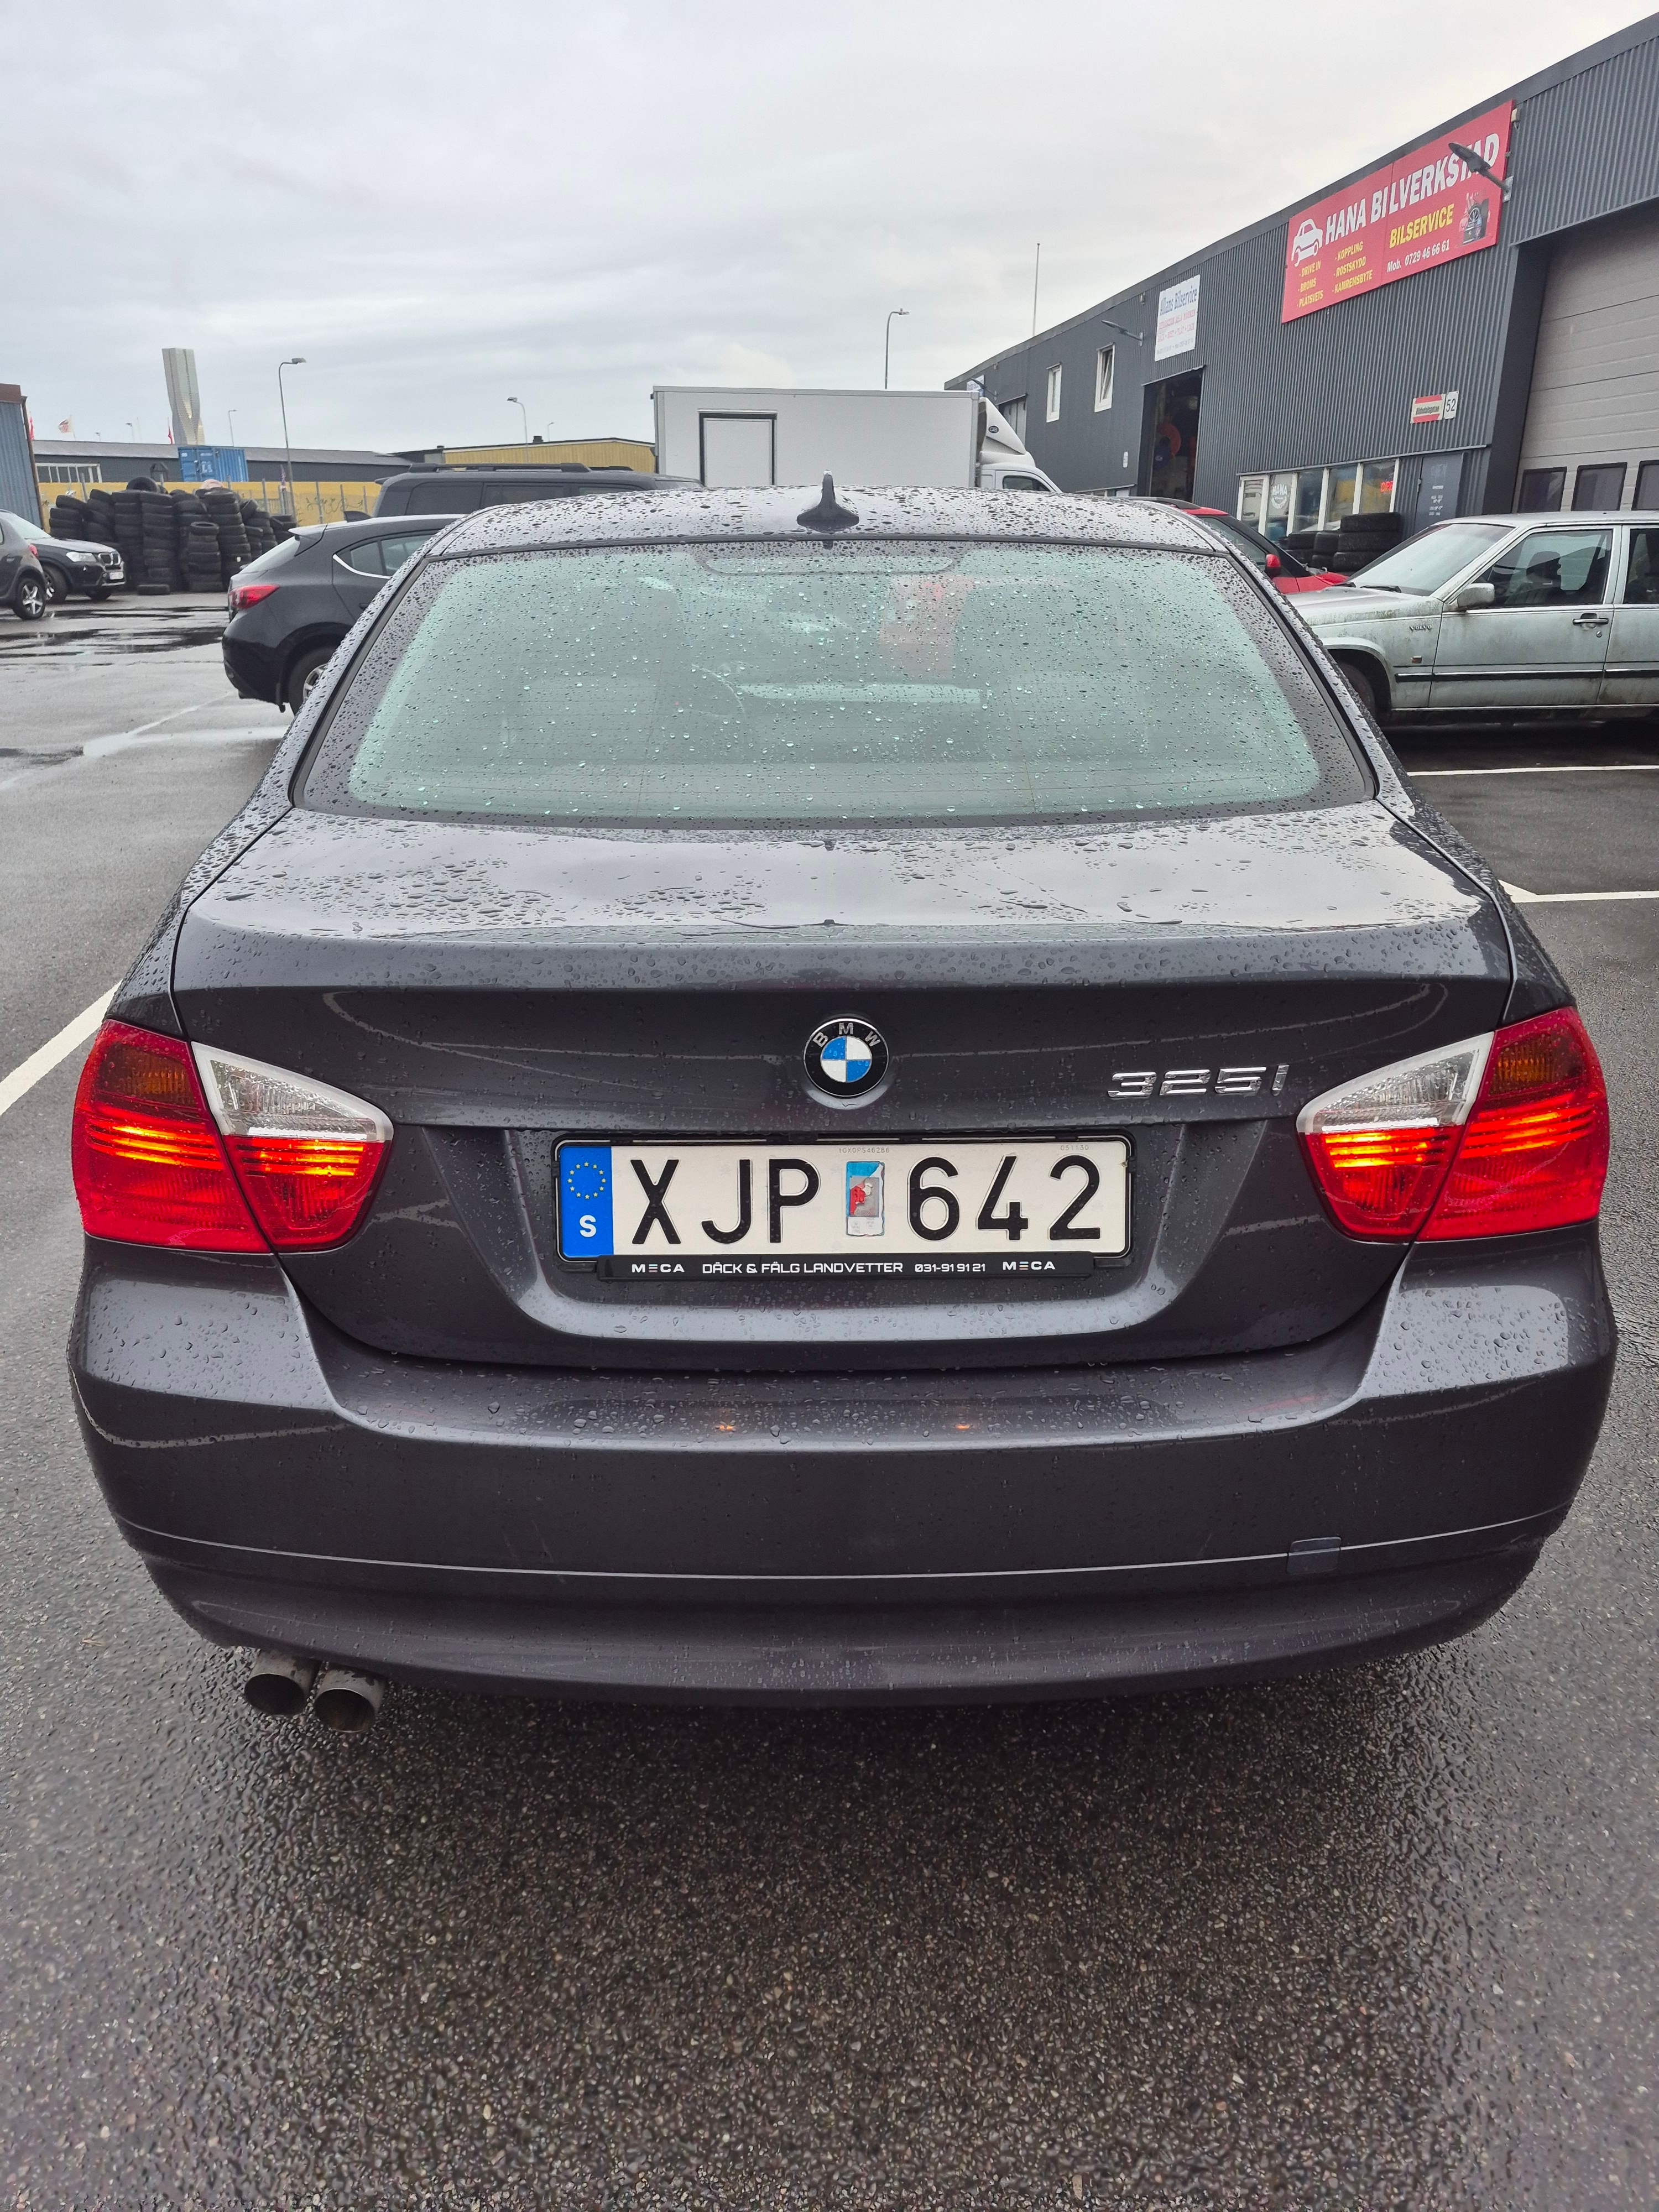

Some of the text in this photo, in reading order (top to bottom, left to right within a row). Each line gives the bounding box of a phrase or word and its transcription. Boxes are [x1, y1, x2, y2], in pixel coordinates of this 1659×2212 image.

[1324, 199, 1366, 245] HANA
[1389, 204, 1454, 248] BILSERVICE
[1337, 241, 1364, 261] KOPPLING
[1387, 238, 1450, 273] Mob. 0729 46 66 61
[1301, 260, 1321, 277] DRIVE IN
[1335, 256, 1366, 277] ROSTSKYDD
[1300, 278, 1316, 293] BROMS
[1334, 269, 1373, 294] KAMREMSBYTE
[1175, 285, 1197, 310] Bilservice
[1446, 398, 1456, 413] 52
[1272, 484, 1287, 496] HANA
[813, 1022, 881, 1047] BMW
[630, 1155, 1100, 1244] XJP 642
[579, 1214, 597, 1238] S
[702, 1262, 742, 1274] DÄCK
[746, 1264, 758, 1273] &
[761, 1261, 800, 1273] FÄLG
[804, 1262, 903, 1273] LANDVETTER
[957, 1263, 969, 1272] 91
[972, 1263, 985, 1272] 21
